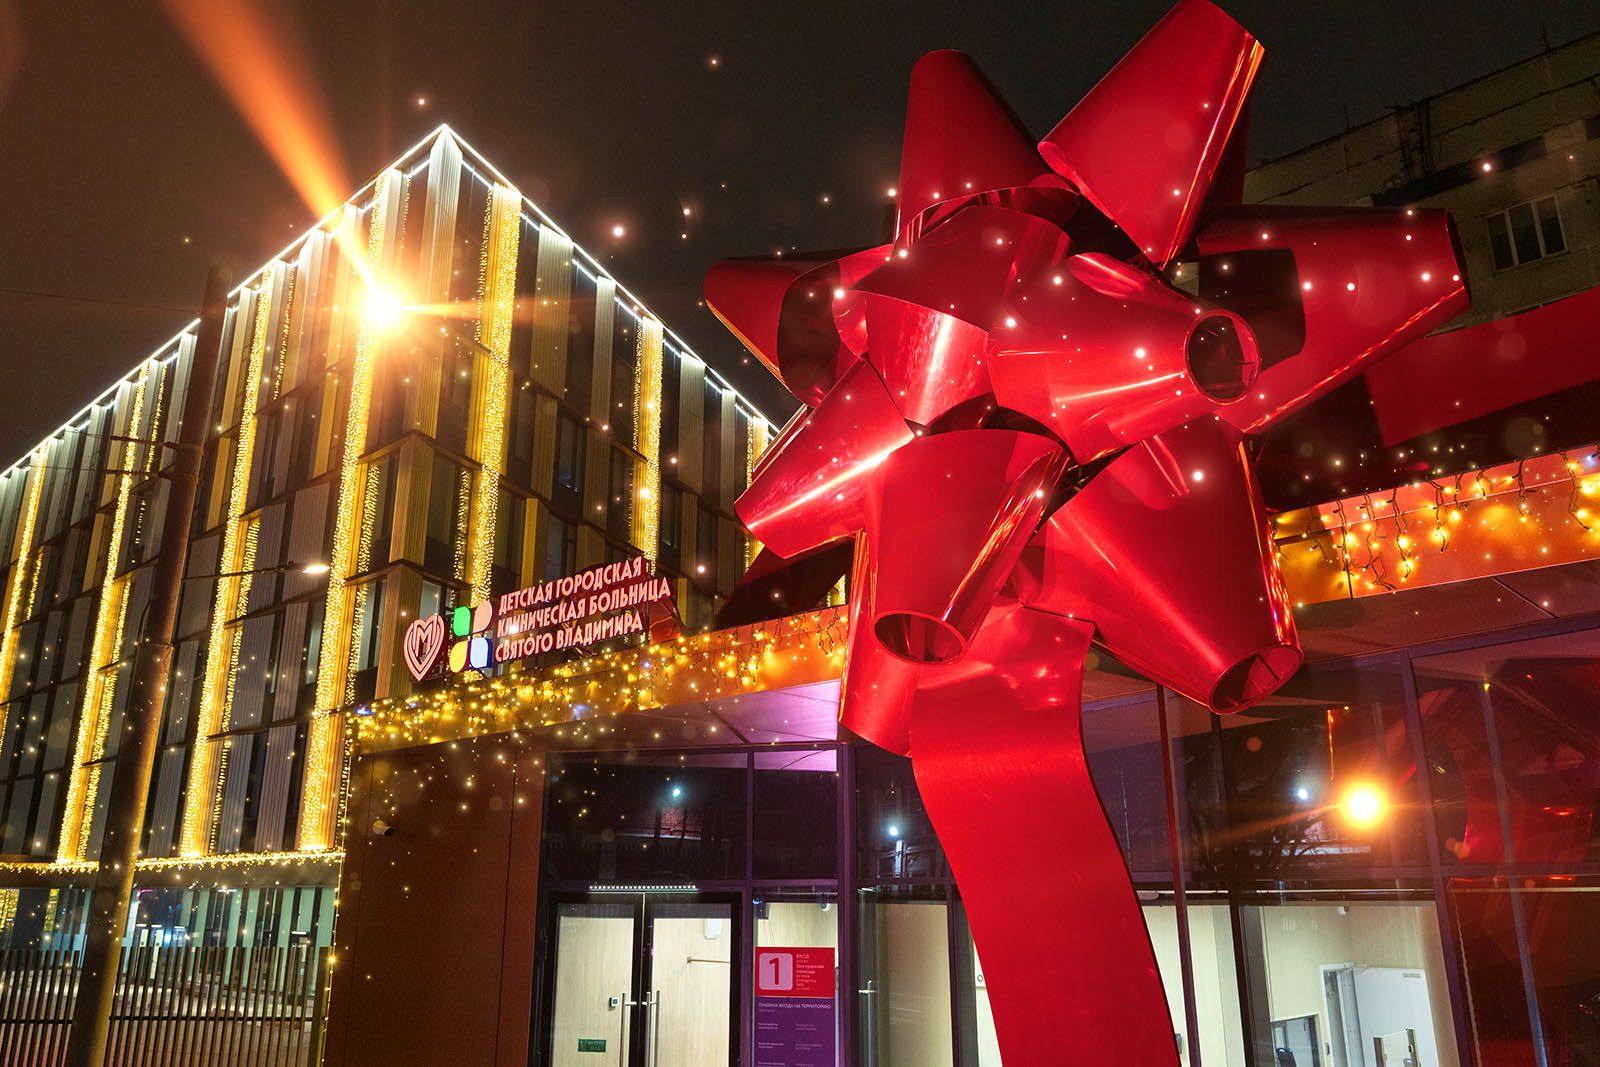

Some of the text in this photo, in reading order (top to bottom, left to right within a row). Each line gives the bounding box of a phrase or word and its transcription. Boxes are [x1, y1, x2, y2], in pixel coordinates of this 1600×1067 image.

[497, 577, 671, 637] КЛИНИЧЕСКАЯ БОЛЬНИЦА
[499, 556, 642, 615] ДЕТСКАЯ ГОРОДСКАЯ
[495, 611, 643, 662] СВЯТОГО ВЛАДИМИРА
[769, 957, 780, 986] 1
